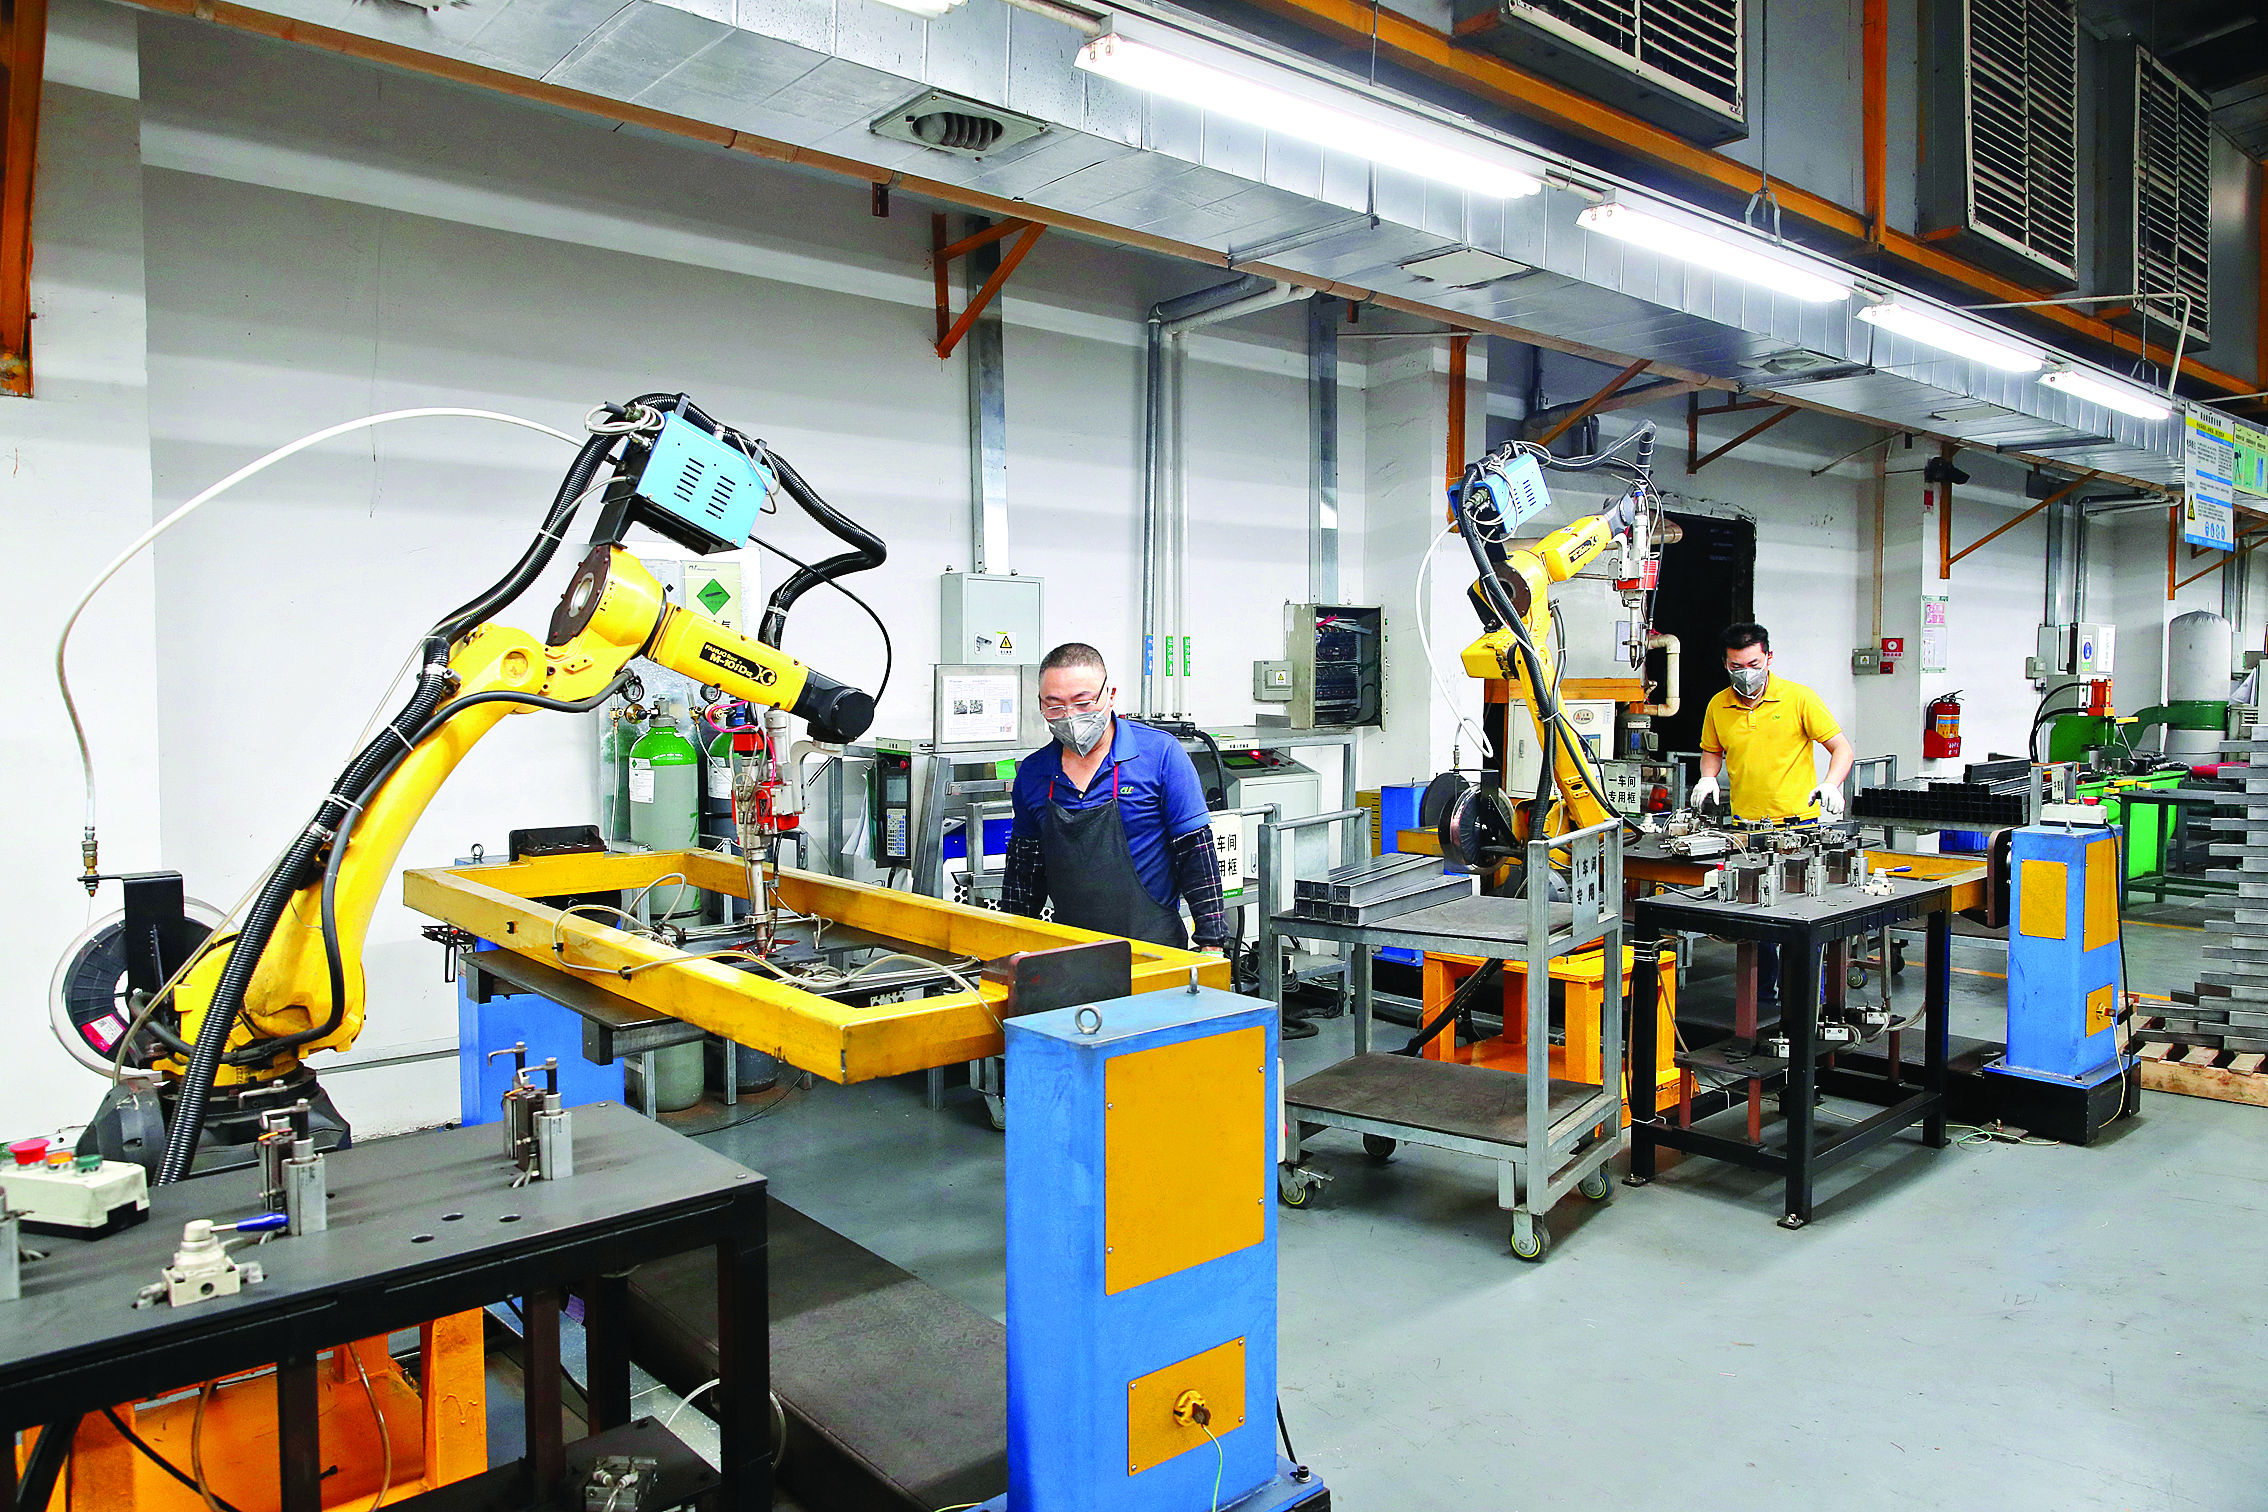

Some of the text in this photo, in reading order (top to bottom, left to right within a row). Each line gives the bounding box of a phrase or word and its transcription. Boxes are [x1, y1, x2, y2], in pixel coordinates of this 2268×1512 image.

[704, 644, 727, 658] FANUC
[1608, 774, 1636, 788] 一车间
[1608, 790, 1636, 804] 专用框
[1216, 834, 1237, 853] 车间
[1218, 858, 1238, 877] 用框
